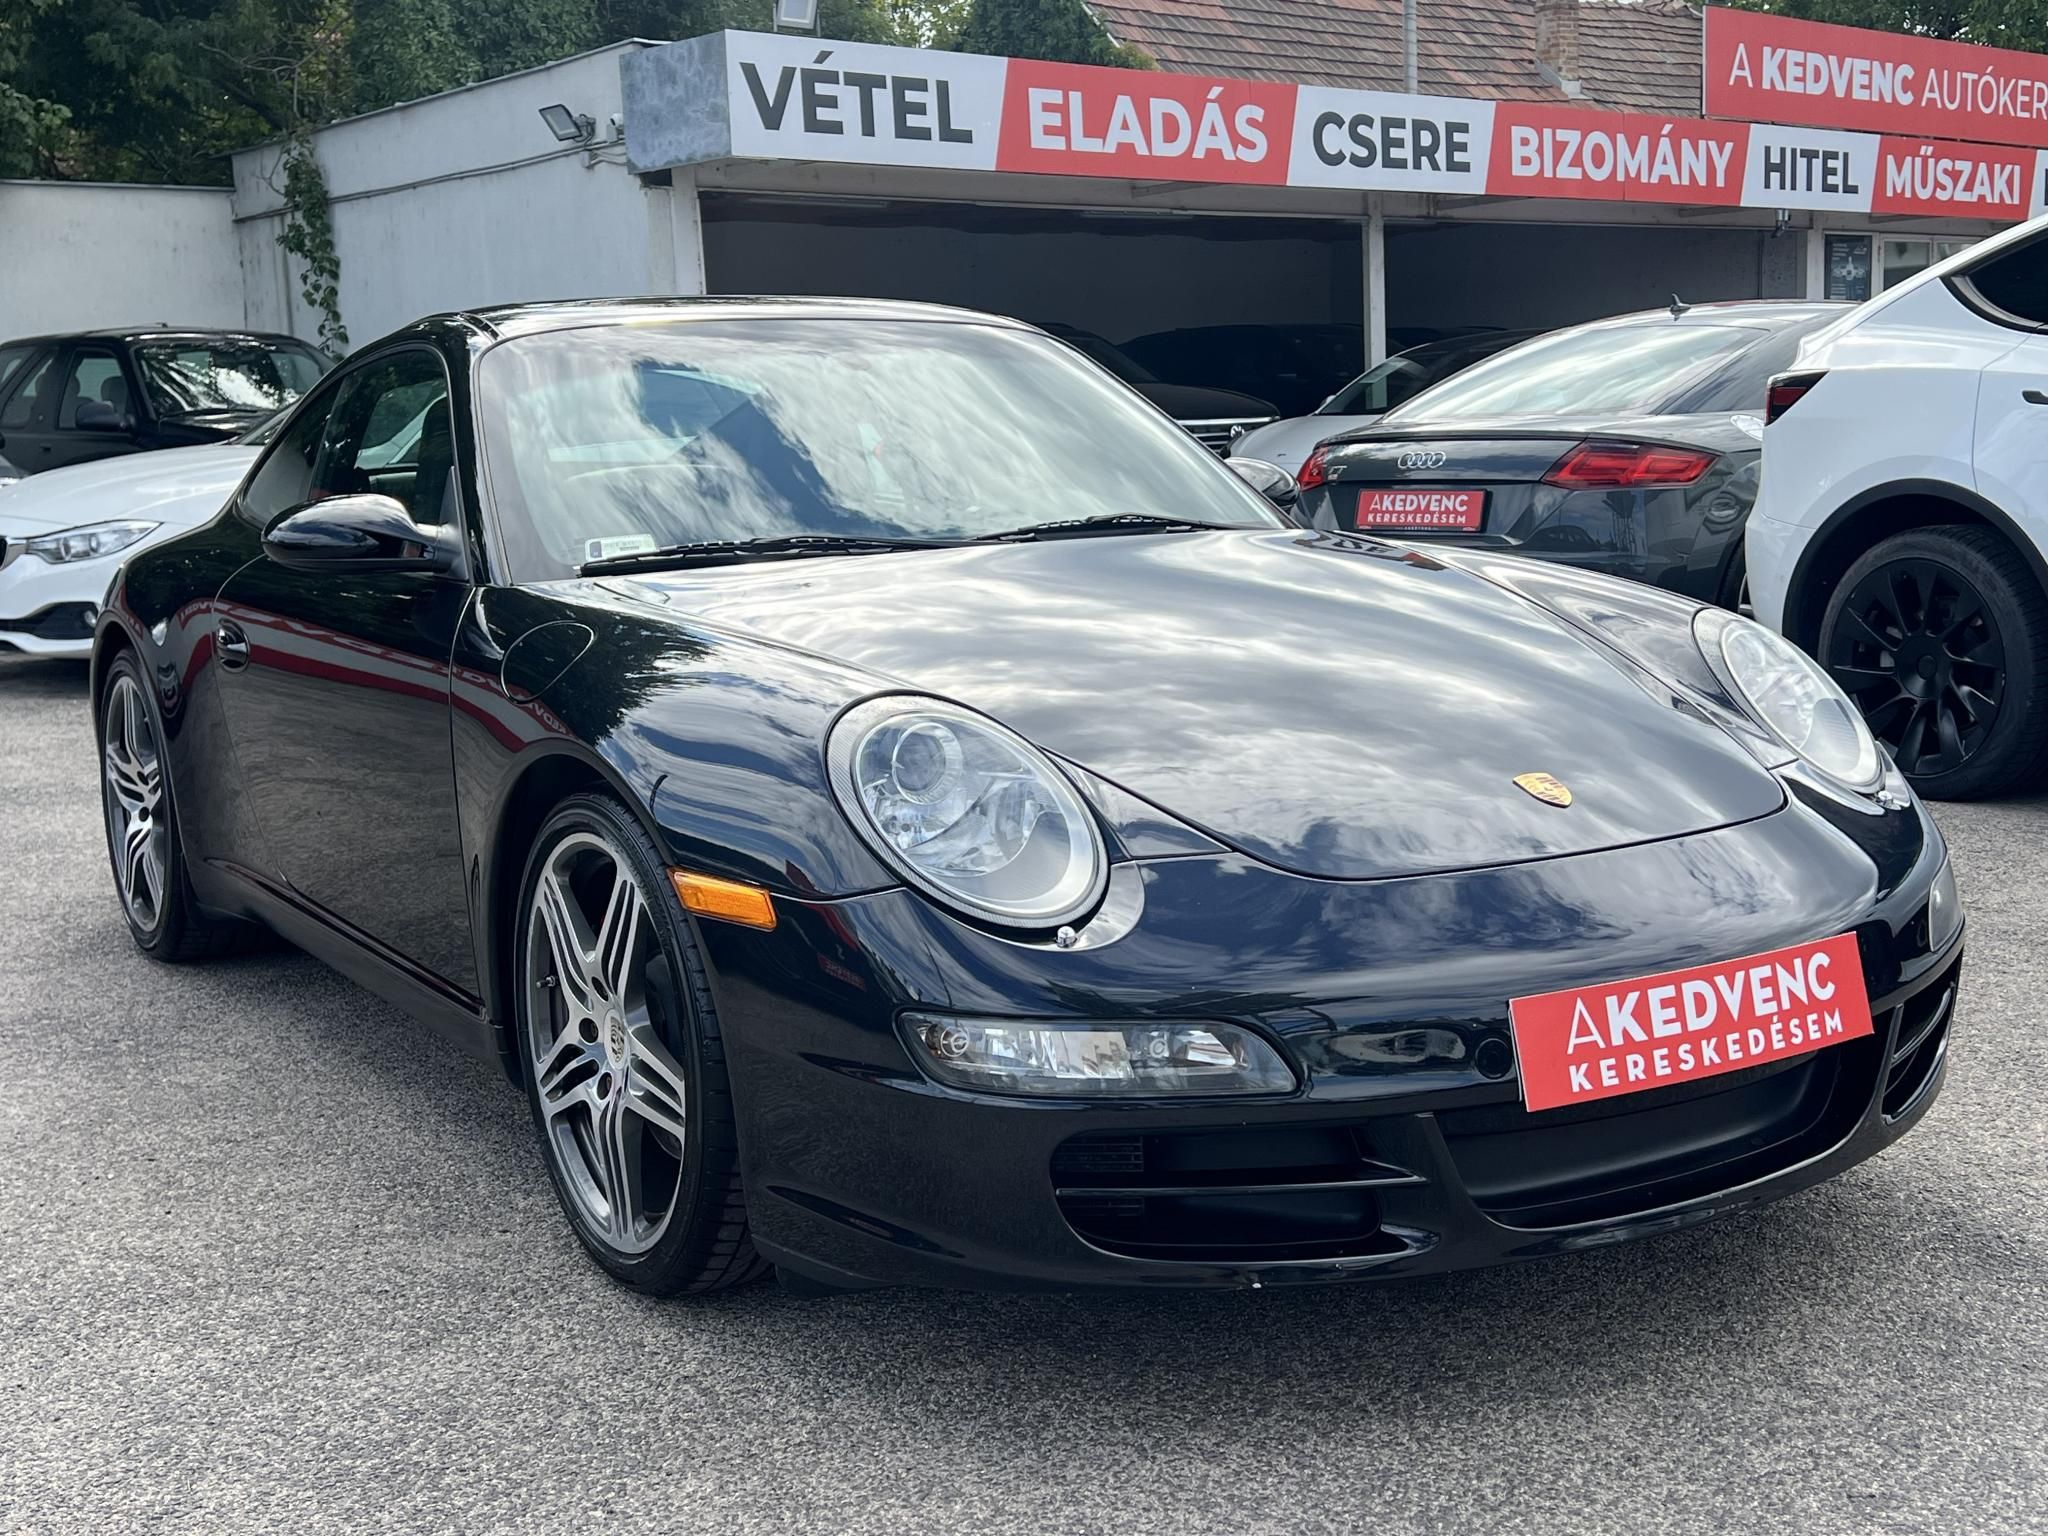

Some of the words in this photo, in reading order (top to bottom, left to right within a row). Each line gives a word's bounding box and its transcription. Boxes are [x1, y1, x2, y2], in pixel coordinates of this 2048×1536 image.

[1728, 42, 1754, 89] A
[1761, 45, 1915, 106] KEDVENC
[1920, 66, 2048, 121] AUTÓKER
[739, 50, 974, 145] VÉTEL
[1027, 86, 1269, 163] ELADÁS
[1312, 111, 1471, 173] CSERE
[1510, 124, 1735, 188] BIZOMÁNY
[1763, 145, 1859, 195] HITEL
[1885, 145, 2021, 205] MŰSZAKI
[1367, 512, 1466, 524] KERESKEDÉSEM
[1568, 1008, 1844, 1093] KERESKEDÉSEM
